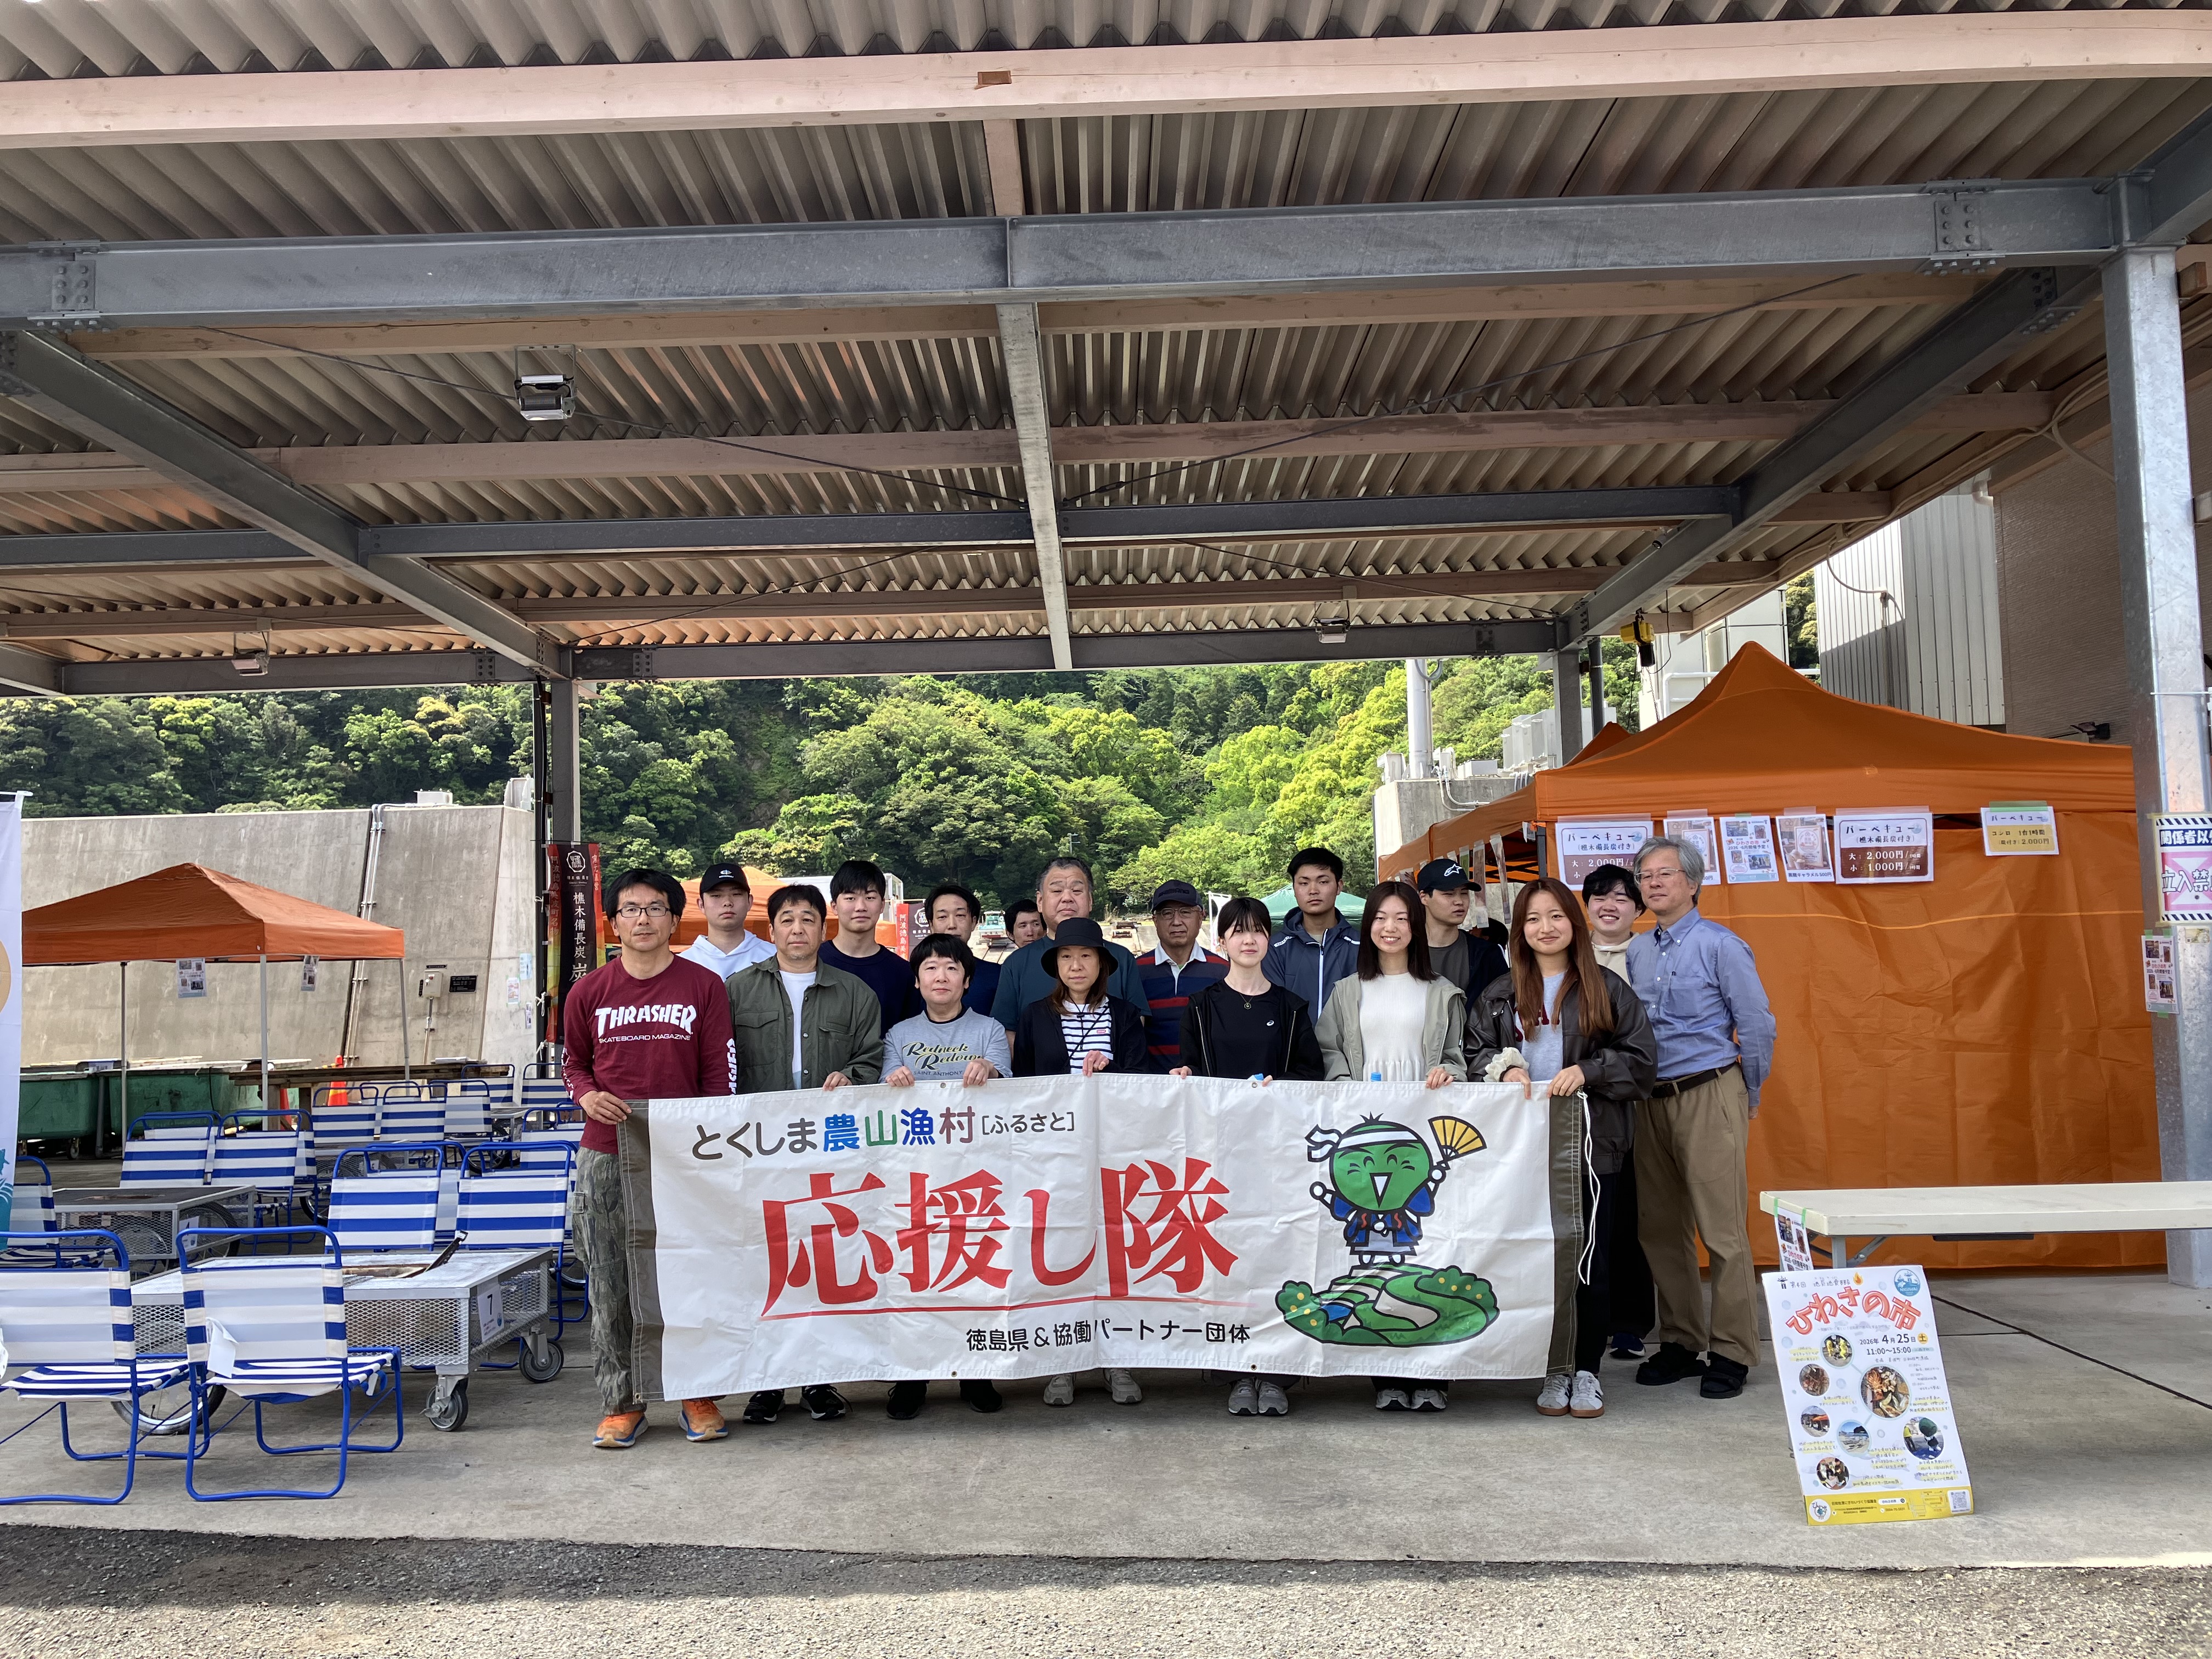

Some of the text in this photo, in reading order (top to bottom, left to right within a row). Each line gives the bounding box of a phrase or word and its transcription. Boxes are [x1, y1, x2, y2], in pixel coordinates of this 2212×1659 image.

[1568, 832, 1635, 842] バーベキュー
[1846, 825, 1915, 834] バーベキュー
[2160, 830, 2212, 845] 関係者以
[2161, 868, 2212, 893] 立入禁
[573, 891, 586, 959] 樵木備長炭
[595, 1003, 696, 1039] THRASHER
[599, 1035, 651, 1043] SKATEBOARD
[902, 1042, 968, 1057] Redneck
[761, 1156, 1239, 1317] 応援し隊
[1785, 1286, 1922, 1335] ひわさの市
